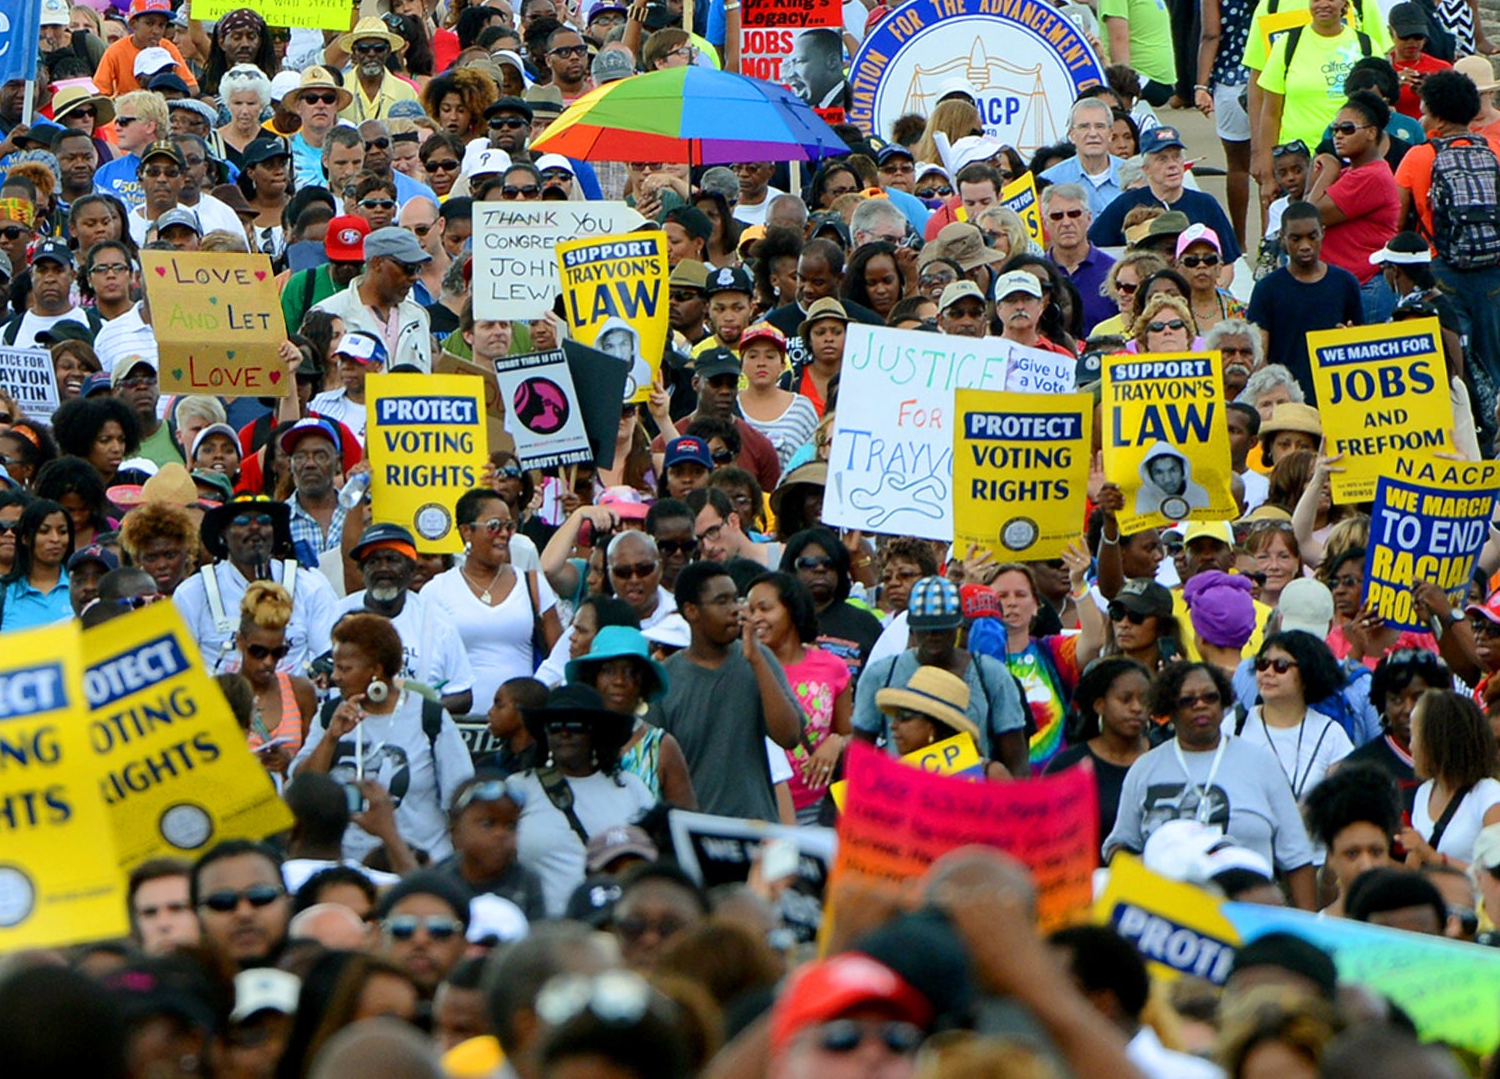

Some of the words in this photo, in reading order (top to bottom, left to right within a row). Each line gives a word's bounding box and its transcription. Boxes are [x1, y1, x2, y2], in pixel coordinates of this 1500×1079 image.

[887, 10, 925, 42] FOR
[742, 30, 794, 55] JOBS
[742, 58, 783, 80] NOT
[482, 210, 559, 227] THANK
[571, 212, 614, 234] YOU
[565, 241, 653, 267] SUPPORT
[171, 258, 248, 285] LOVE
[564, 258, 662, 286] TRAYVON'S
[568, 279, 661, 327] LAW
[169, 303, 219, 330] AND
[227, 303, 271, 331] LET
[24, 356, 44, 368] FOR
[851, 332, 1003, 392] JUSTICE
[1322, 348, 1347, 362] WE
[1347, 341, 1399, 360] MARCH
[1403, 337, 1431, 354] FOR
[189, 355, 262, 388] LOVE
[1115, 359, 1208, 379] SUPPORT
[1020, 377, 1030, 387] a
[1034, 377, 1067, 394] Vote
[1113, 379, 1215, 402] TRAYVON'S
[1329, 360, 1435, 405] JOBS
[382, 397, 474, 422] PROTECT
[898, 399, 943, 429] FOR
[1364, 408, 1409, 429] AND
[970, 414, 1075, 438] PROTECT
[1112, 402, 1215, 447] LAW
[383, 431, 474, 454] VOTING
[971, 445, 1072, 469] VOTING
[385, 464, 475, 488] RIGHTS
[1394, 456, 1495, 485] NAACP
[971, 479, 1069, 502] RIGHTS
[1384, 486, 1418, 509] WE
[1423, 491, 1492, 516] MARCH
[1380, 509, 1420, 545] TO
[1428, 518, 1485, 555] END
